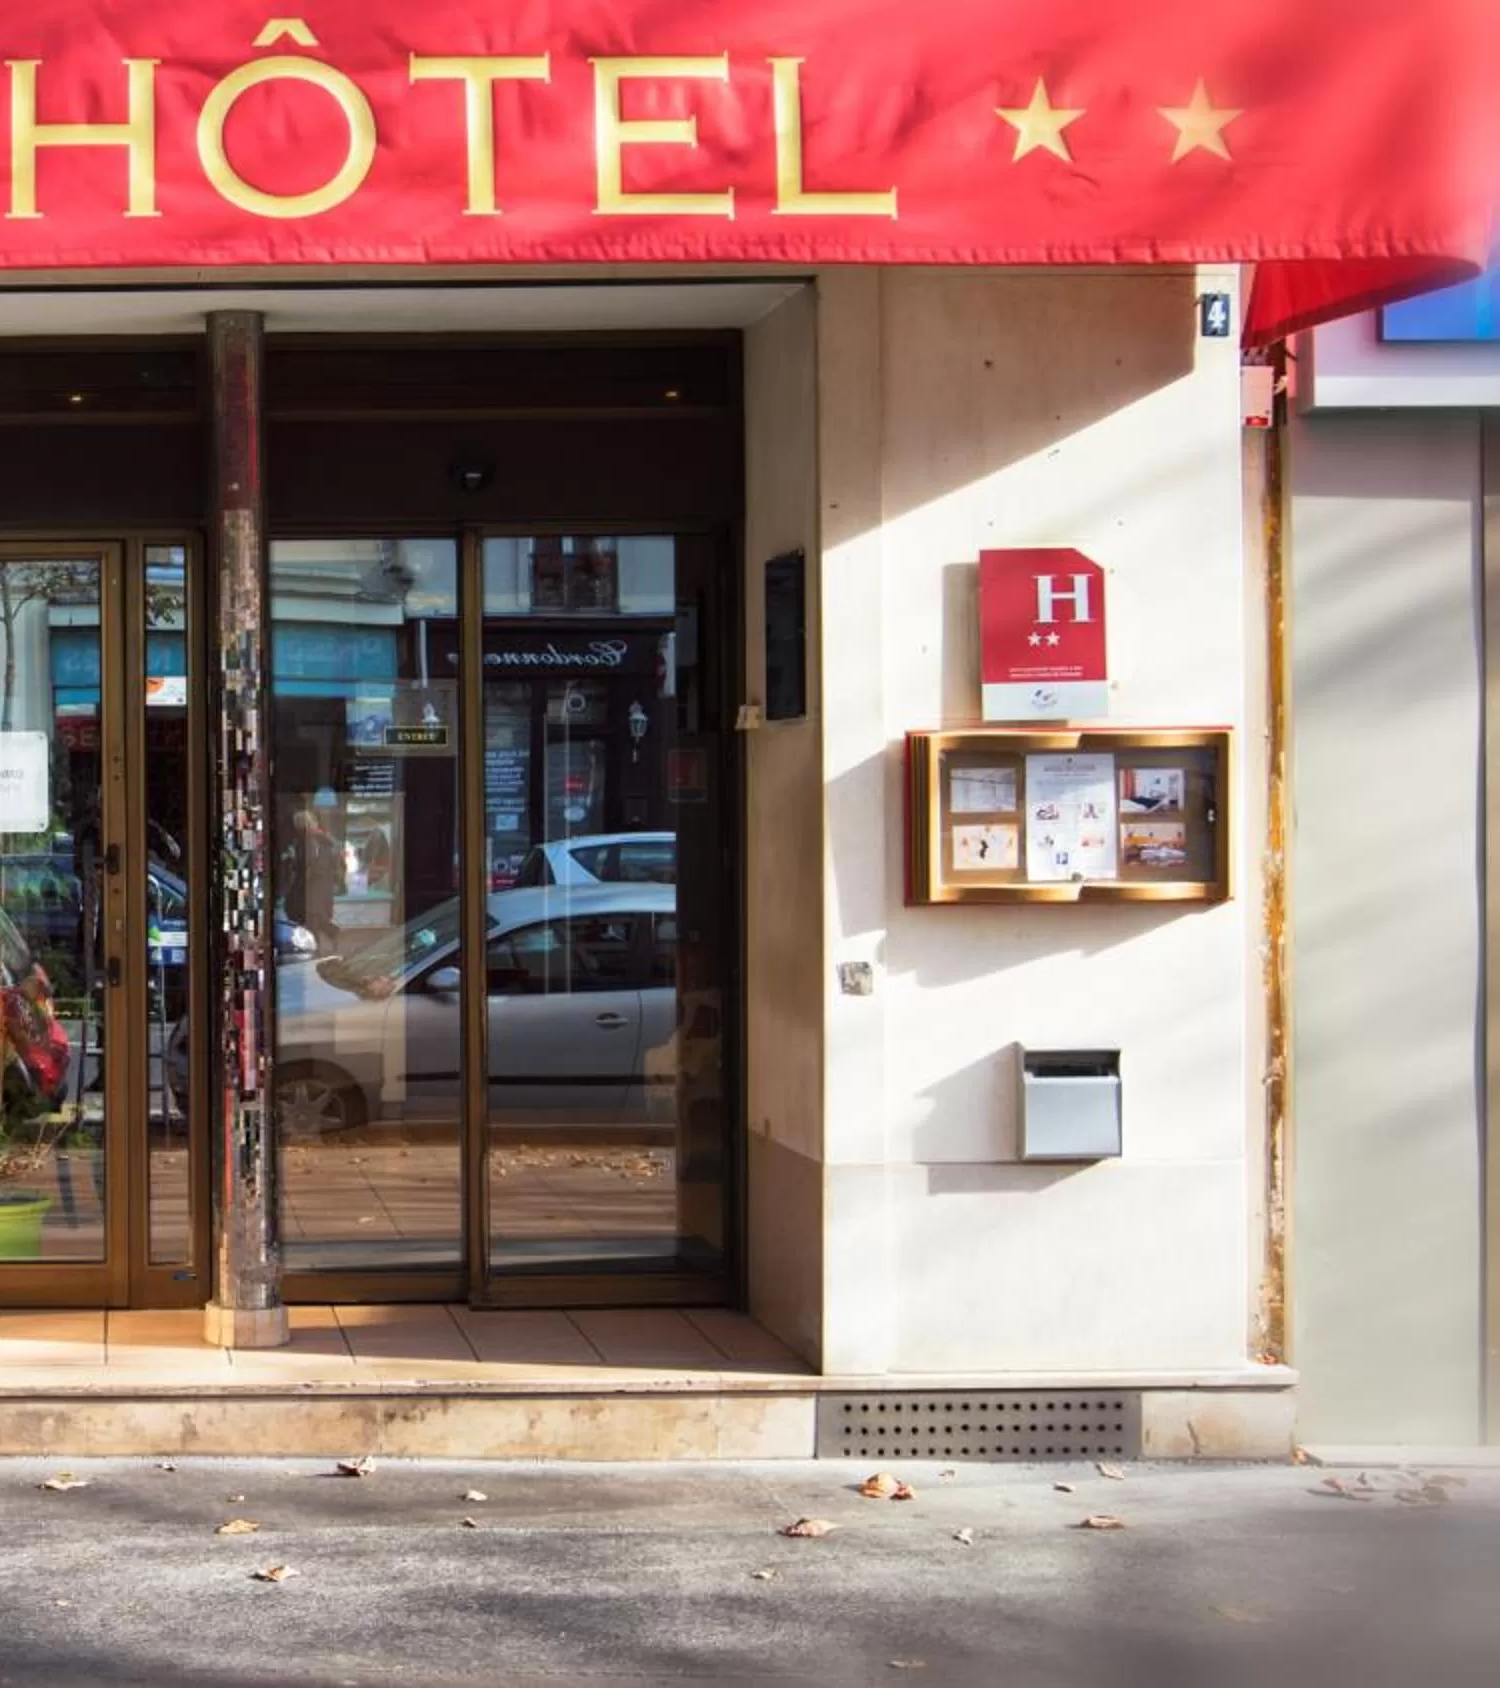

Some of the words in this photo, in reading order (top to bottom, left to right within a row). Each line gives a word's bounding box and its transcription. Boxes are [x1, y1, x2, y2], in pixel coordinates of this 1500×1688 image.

[5, 18, 899, 220] HÔTEL
[1207, 300, 1227, 331] 4
[1031, 573, 1097, 623] H
